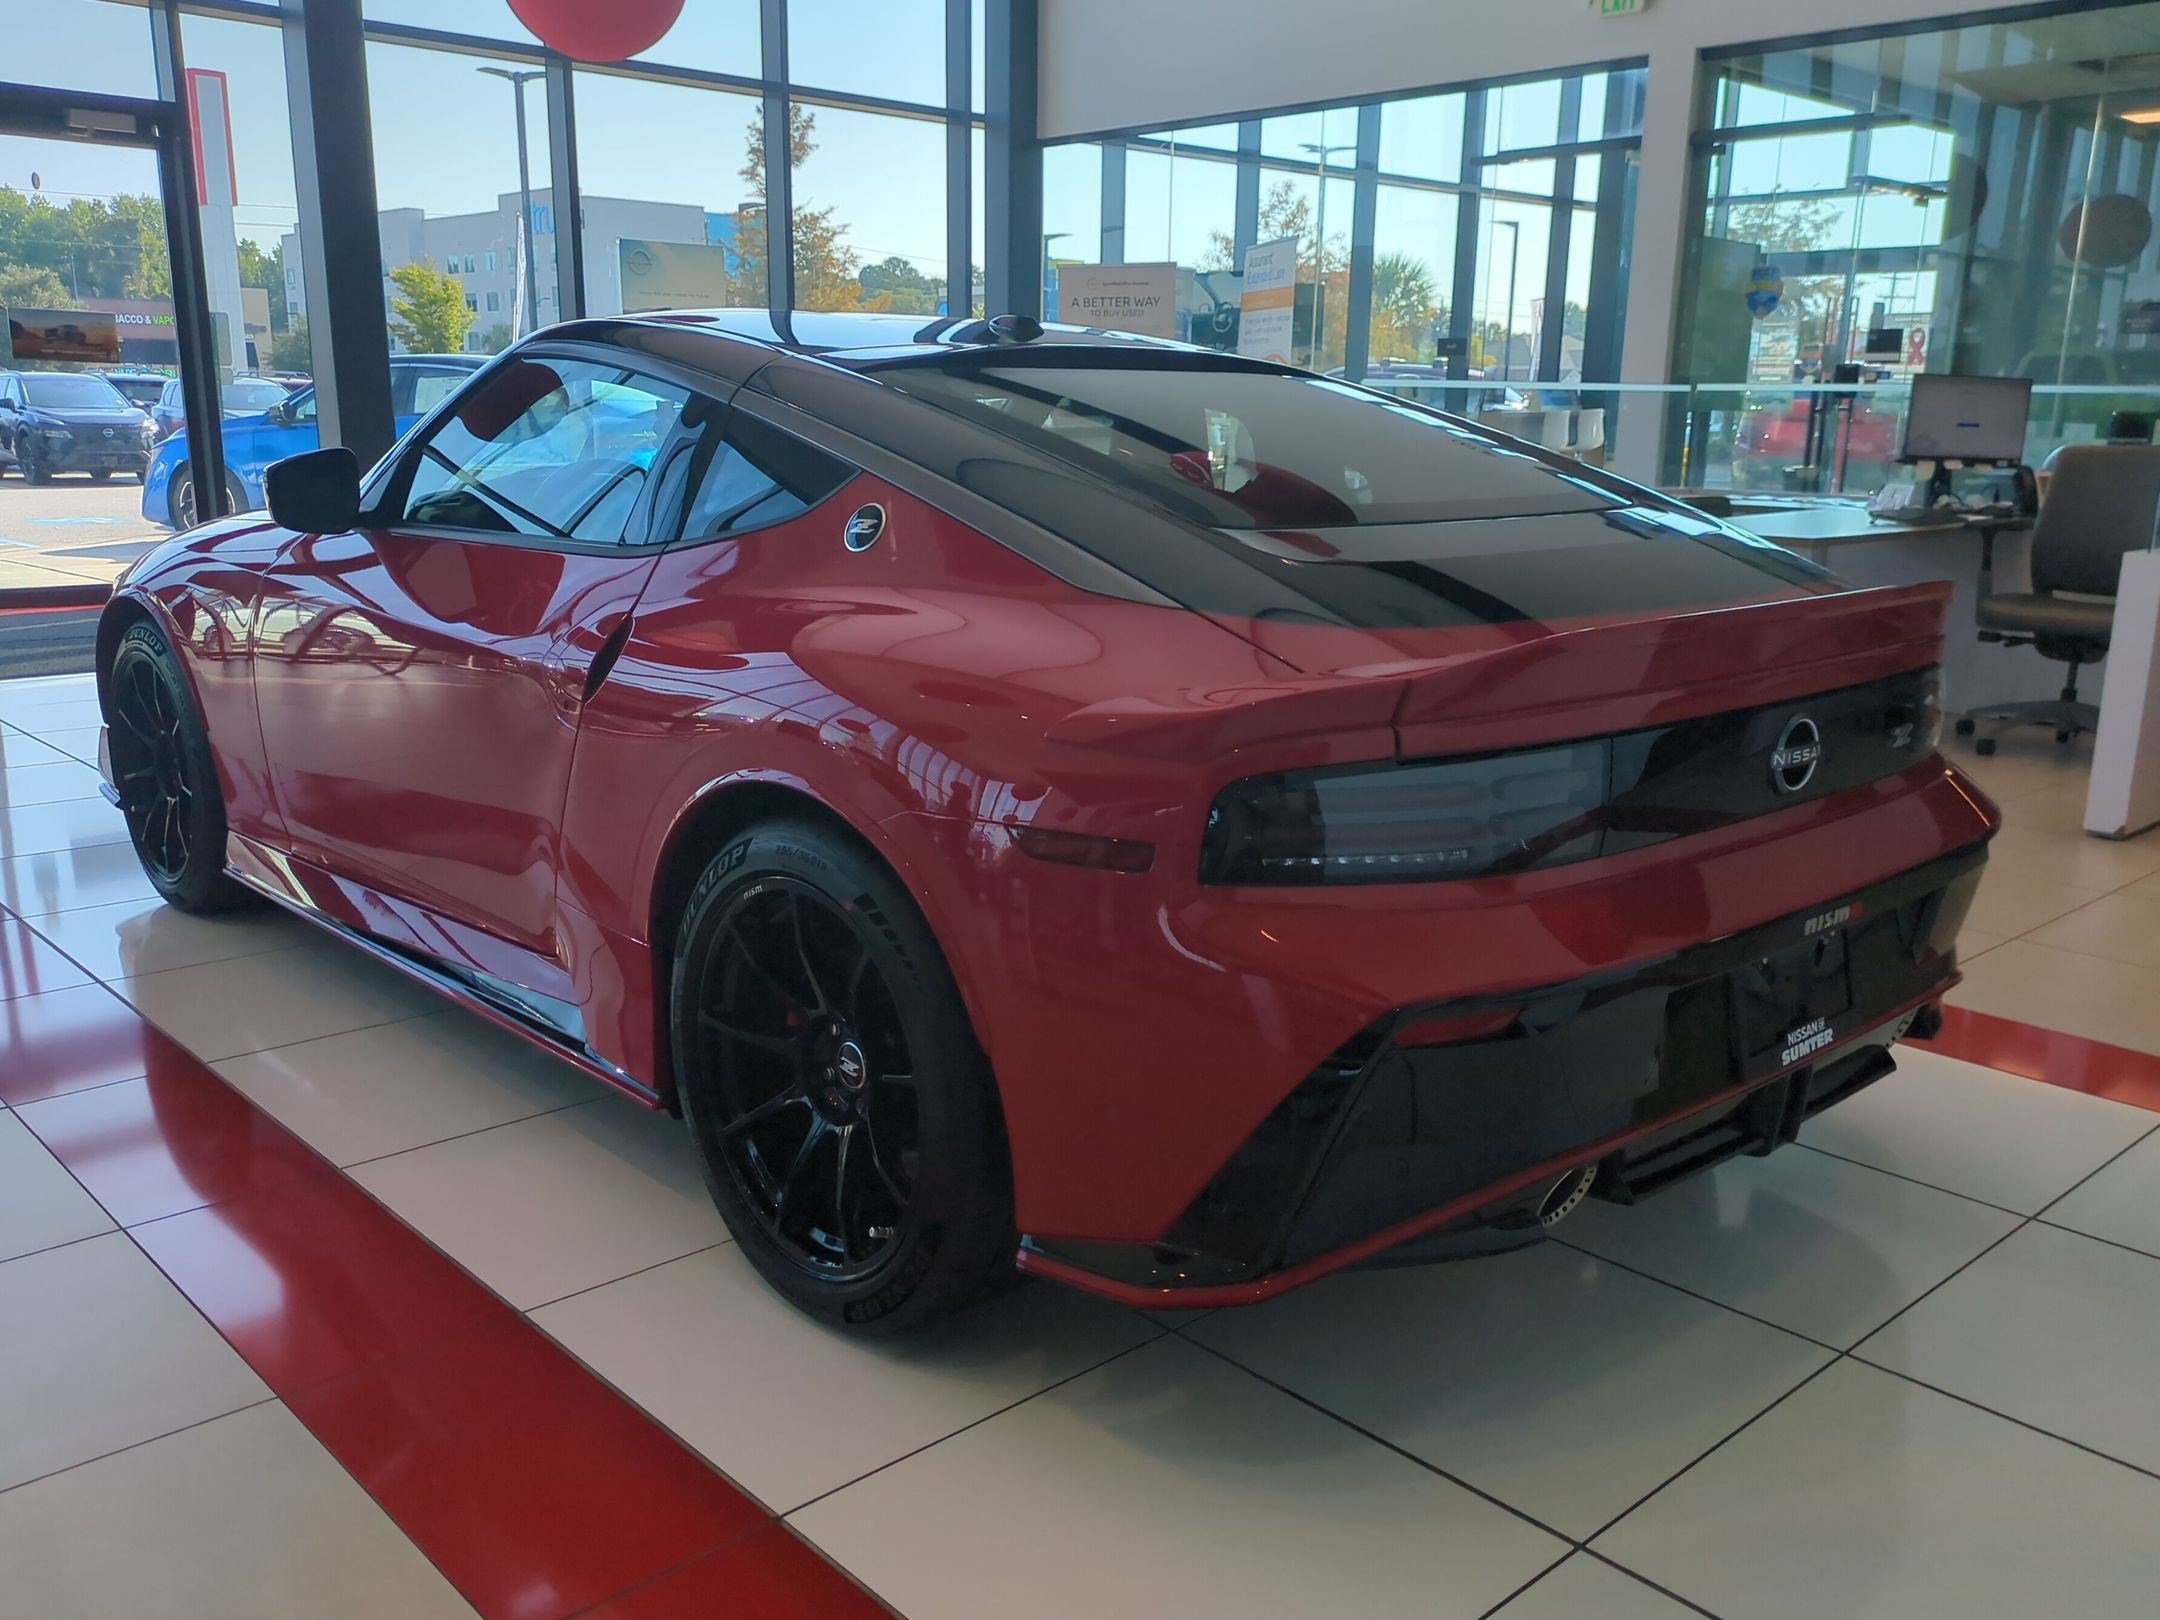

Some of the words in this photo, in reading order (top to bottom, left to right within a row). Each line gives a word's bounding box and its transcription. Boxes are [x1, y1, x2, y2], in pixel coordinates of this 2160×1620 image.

[1071, 297, 1080, 308] A
[1083, 296, 1130, 308] BETTER
[1134, 295, 1161, 307] WAY
[1090, 309, 1101, 317] TO
[1104, 309, 1120, 317] BUY
[1122, 309, 1144, 317] USED
[1773, 746, 1820, 766] NISSA
[683, 845, 745, 937] DUNLOP
[1787, 1021, 1818, 1046] NISSAN
[1781, 1028, 1834, 1066] SUMTER
